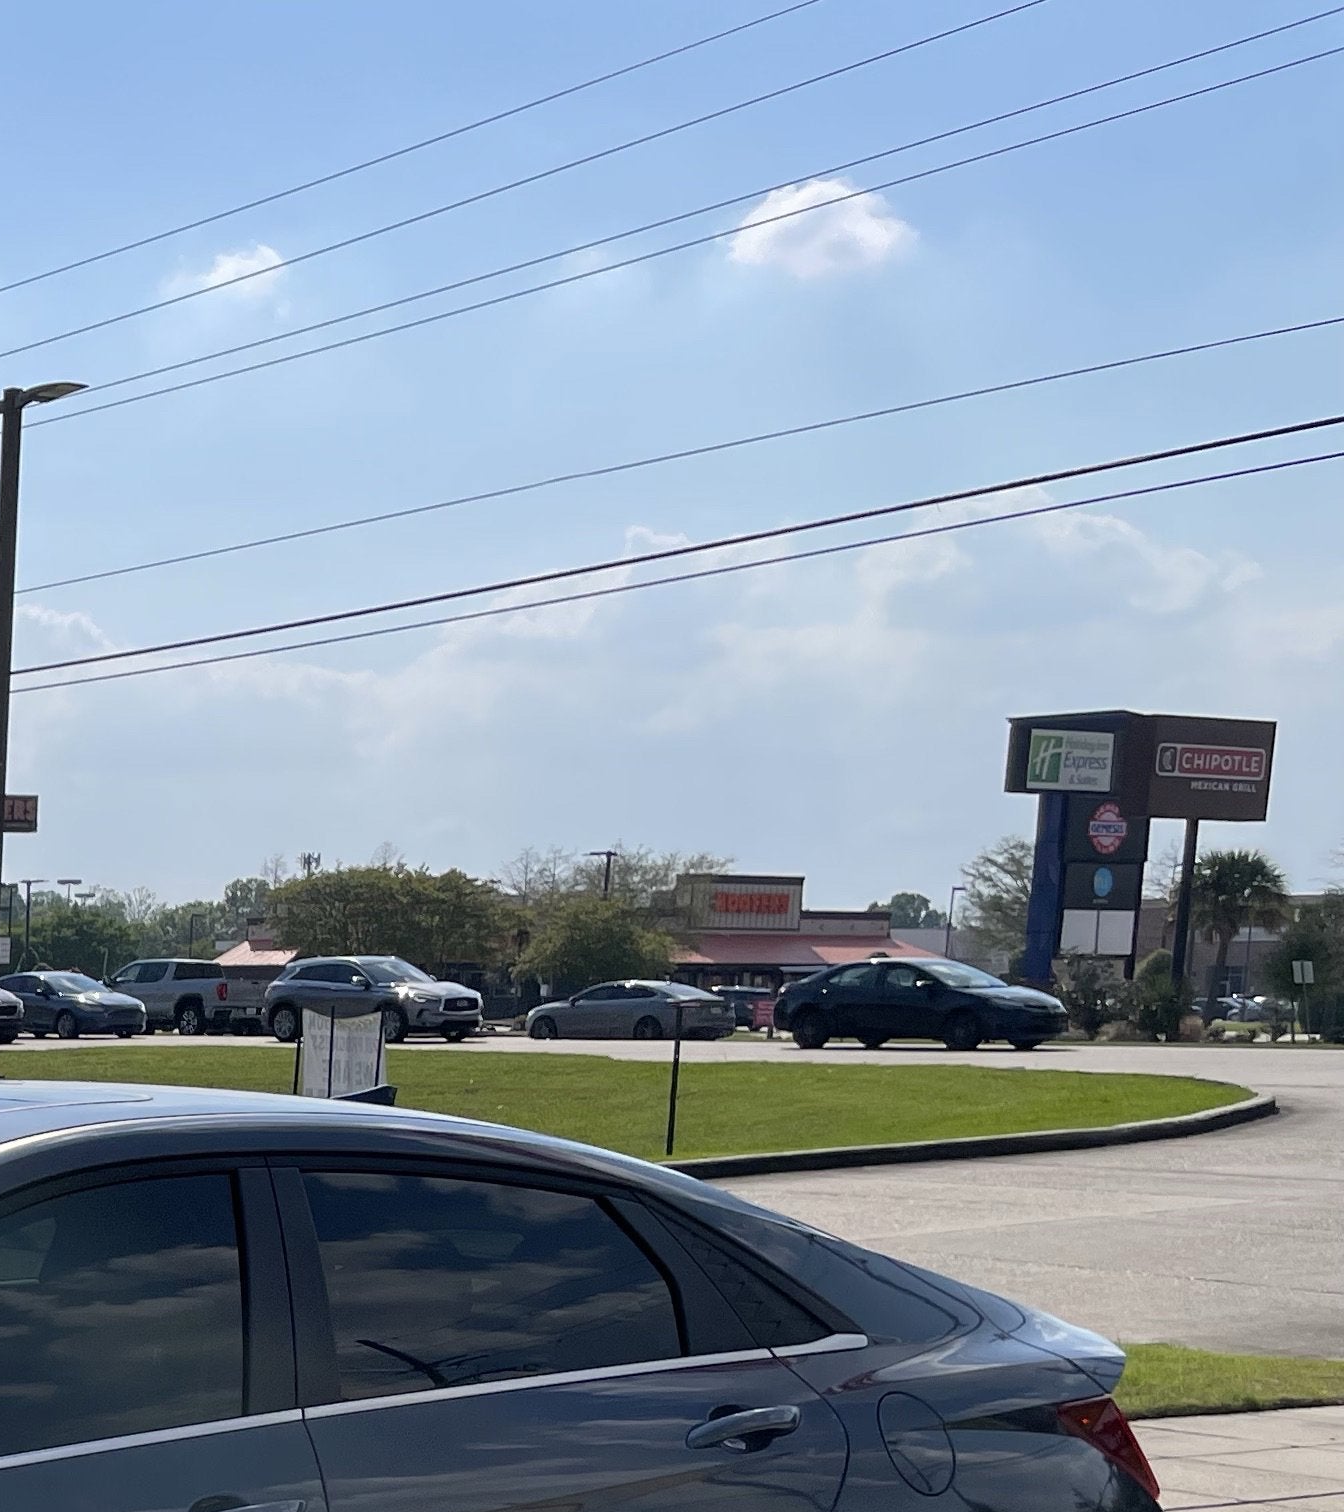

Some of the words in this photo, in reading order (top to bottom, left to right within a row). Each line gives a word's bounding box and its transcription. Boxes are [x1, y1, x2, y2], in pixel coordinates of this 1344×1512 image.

[1063, 751, 1109, 772] Express
[1181, 752, 1261, 772] CHIPOTLE
[1190, 781, 1230, 792] MEXICAN
